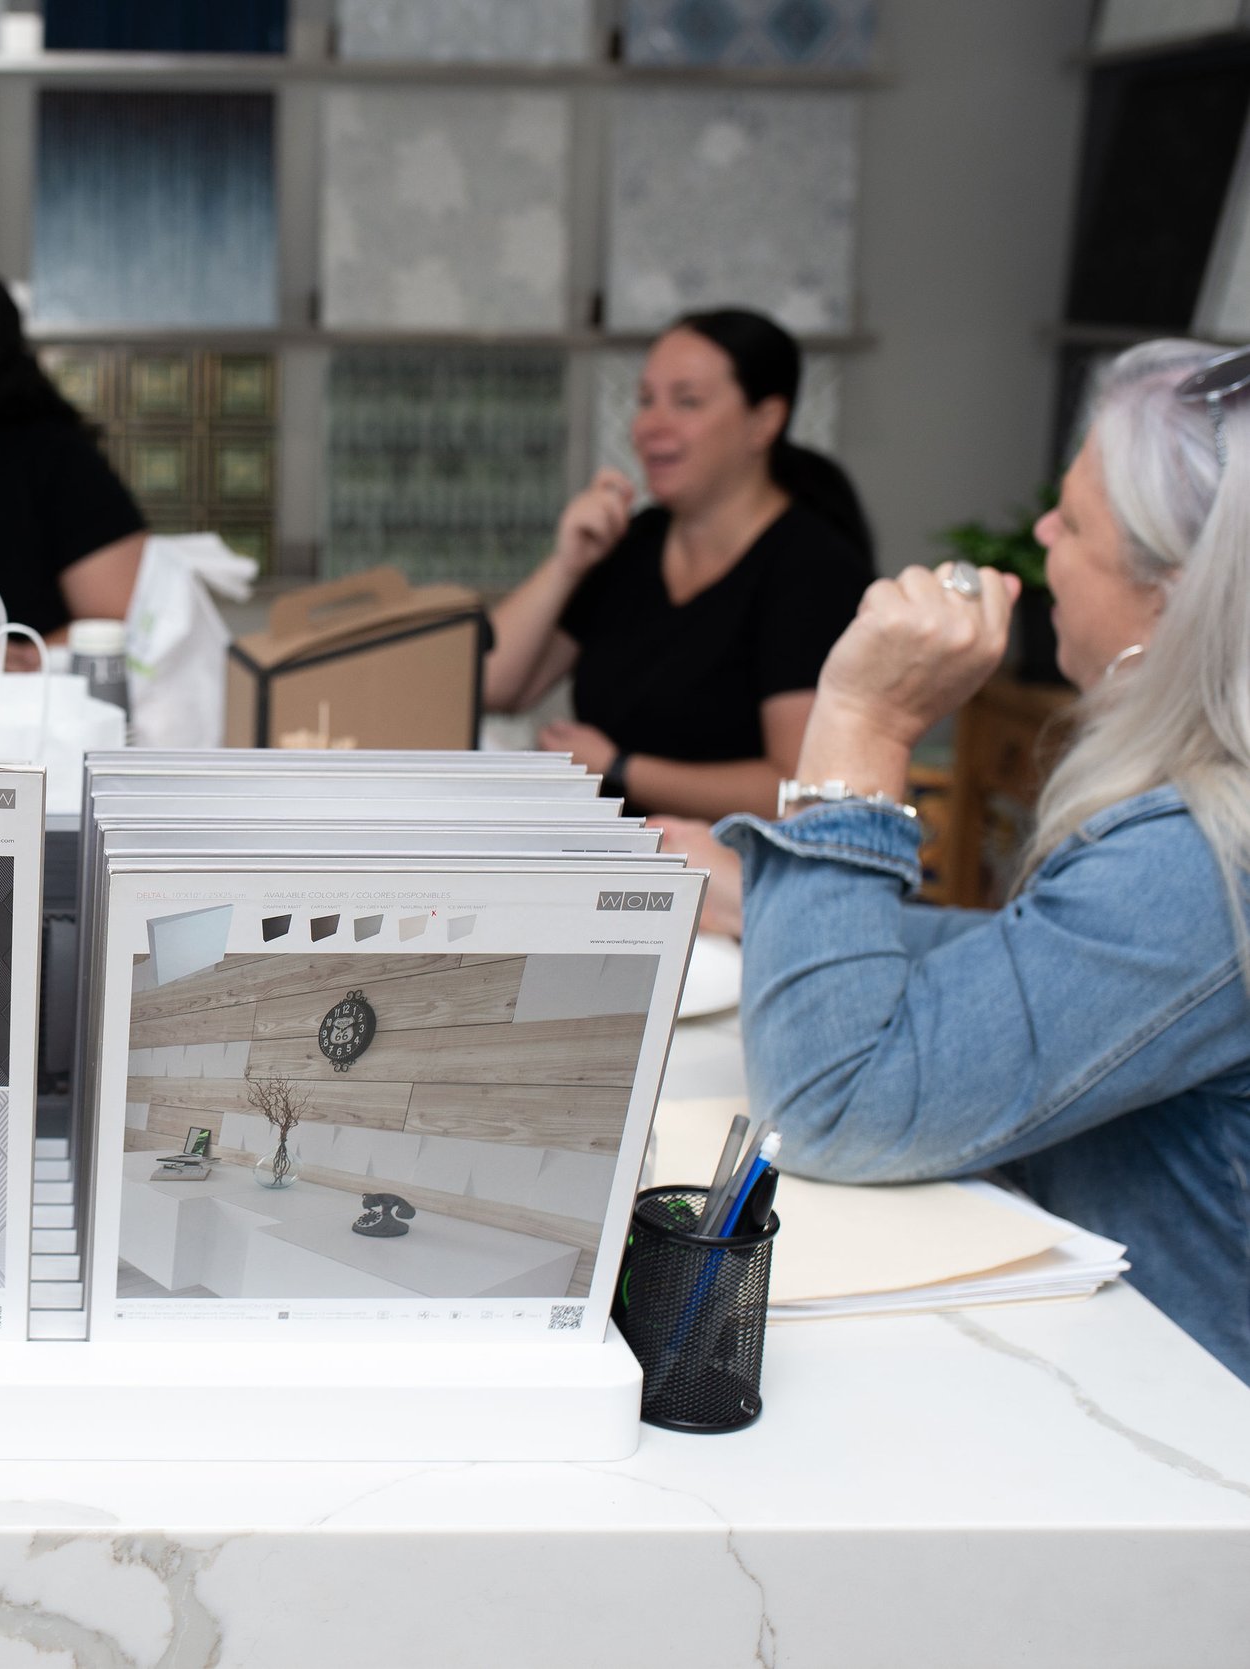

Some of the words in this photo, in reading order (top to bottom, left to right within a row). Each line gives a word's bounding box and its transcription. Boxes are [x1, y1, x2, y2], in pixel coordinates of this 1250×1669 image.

[136, 891, 161, 899] DELTA
[263, 891, 306, 899] AVAILABLE
[308, 891, 349, 899] COLOURS
[355, 891, 396, 899] COLORES
[397, 891, 451, 899] DISPONIBLES
[600, 894, 672, 909] WOW
[589, 938, 665, 946] www.wowdesigneu.com
[334, 1008, 340, 1017] 11
[342, 1005, 350, 1014] 12
[358, 1013, 363, 1022] 2
[359, 1024, 364, 1033] 3
[322, 1030, 327, 1038] 9
[335, 1031, 348, 1041] 66
[323, 1038, 328, 1046] 8
[354, 1036, 360, 1044] 4
[336, 1047, 342, 1056] 6
[346, 1044, 352, 1052] 5
